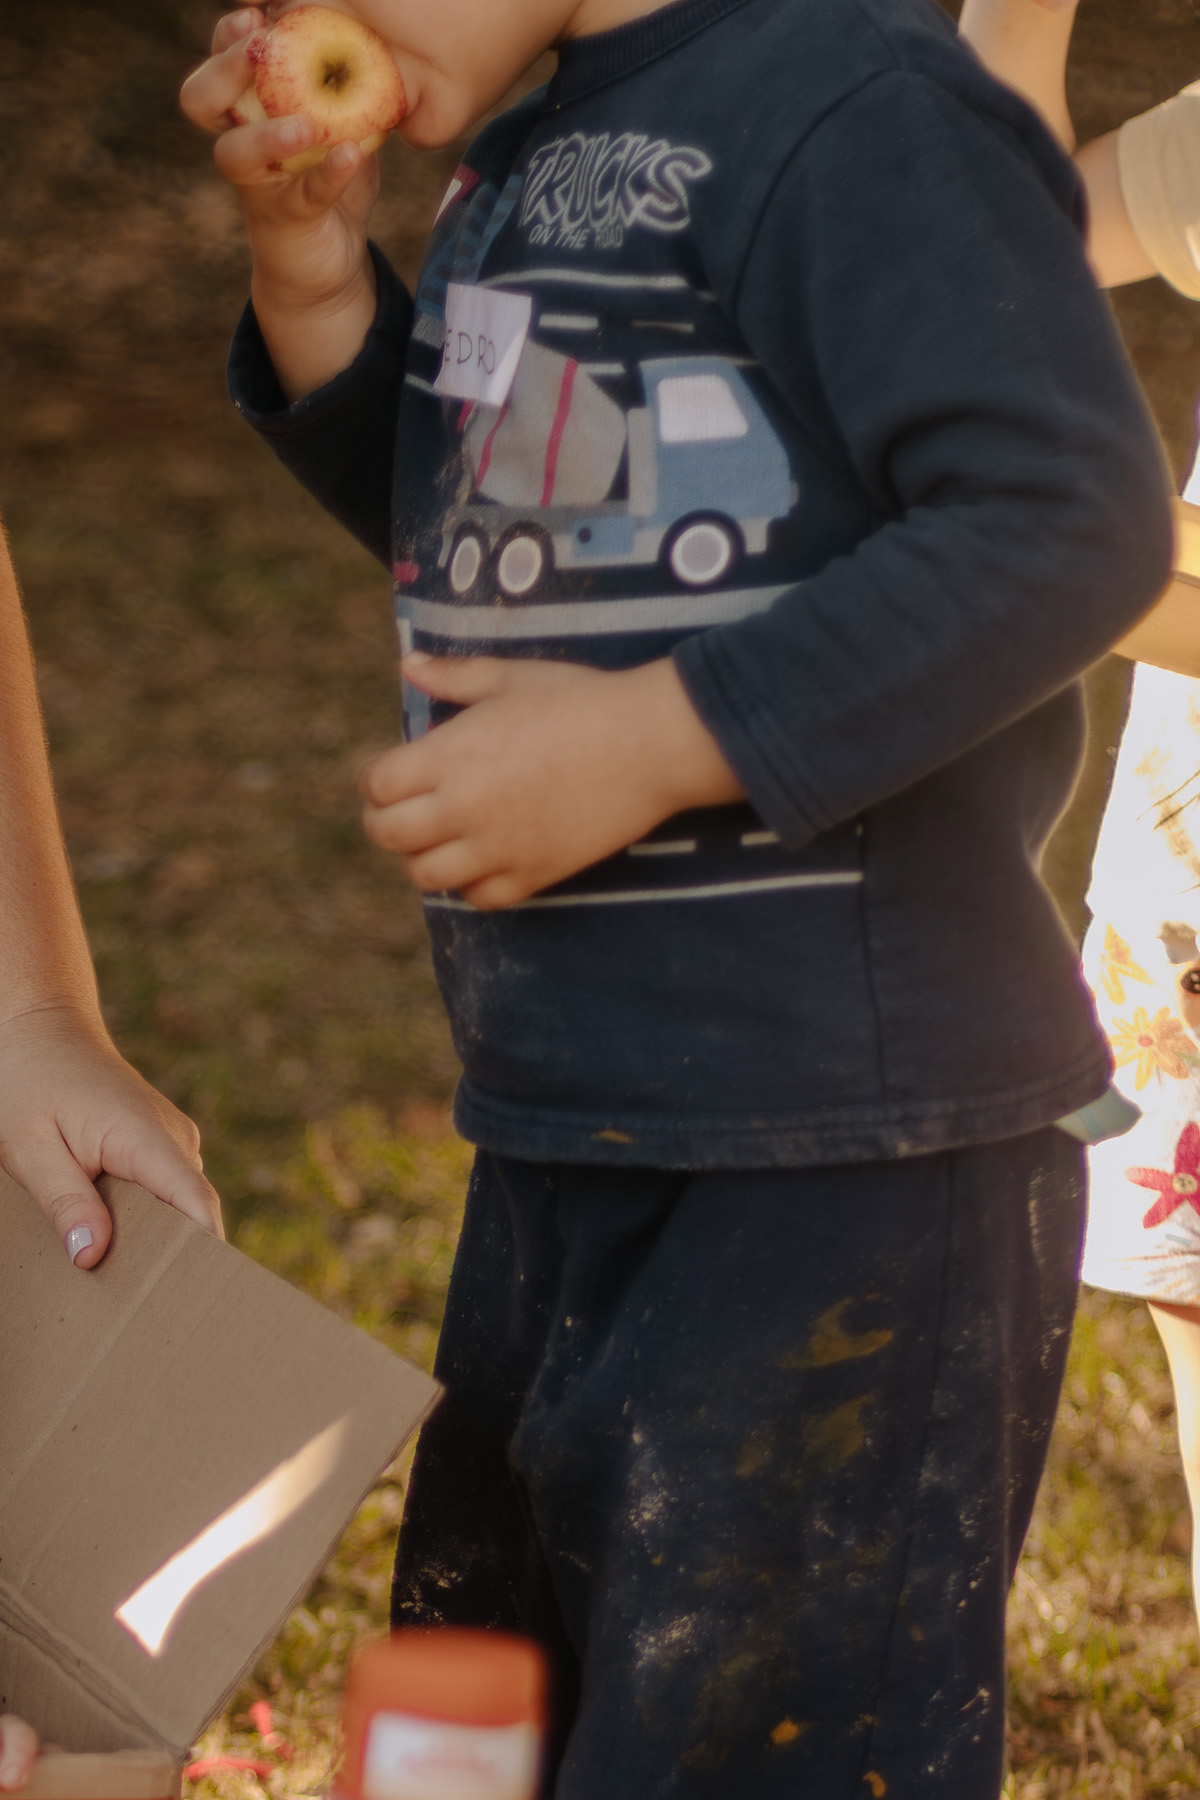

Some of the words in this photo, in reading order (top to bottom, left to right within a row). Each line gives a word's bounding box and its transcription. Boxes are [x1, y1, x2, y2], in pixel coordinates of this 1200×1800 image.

[518, 131, 712, 232] TRUCKS
[528, 223, 557, 245] ON
[554, 225, 591, 249] THE
